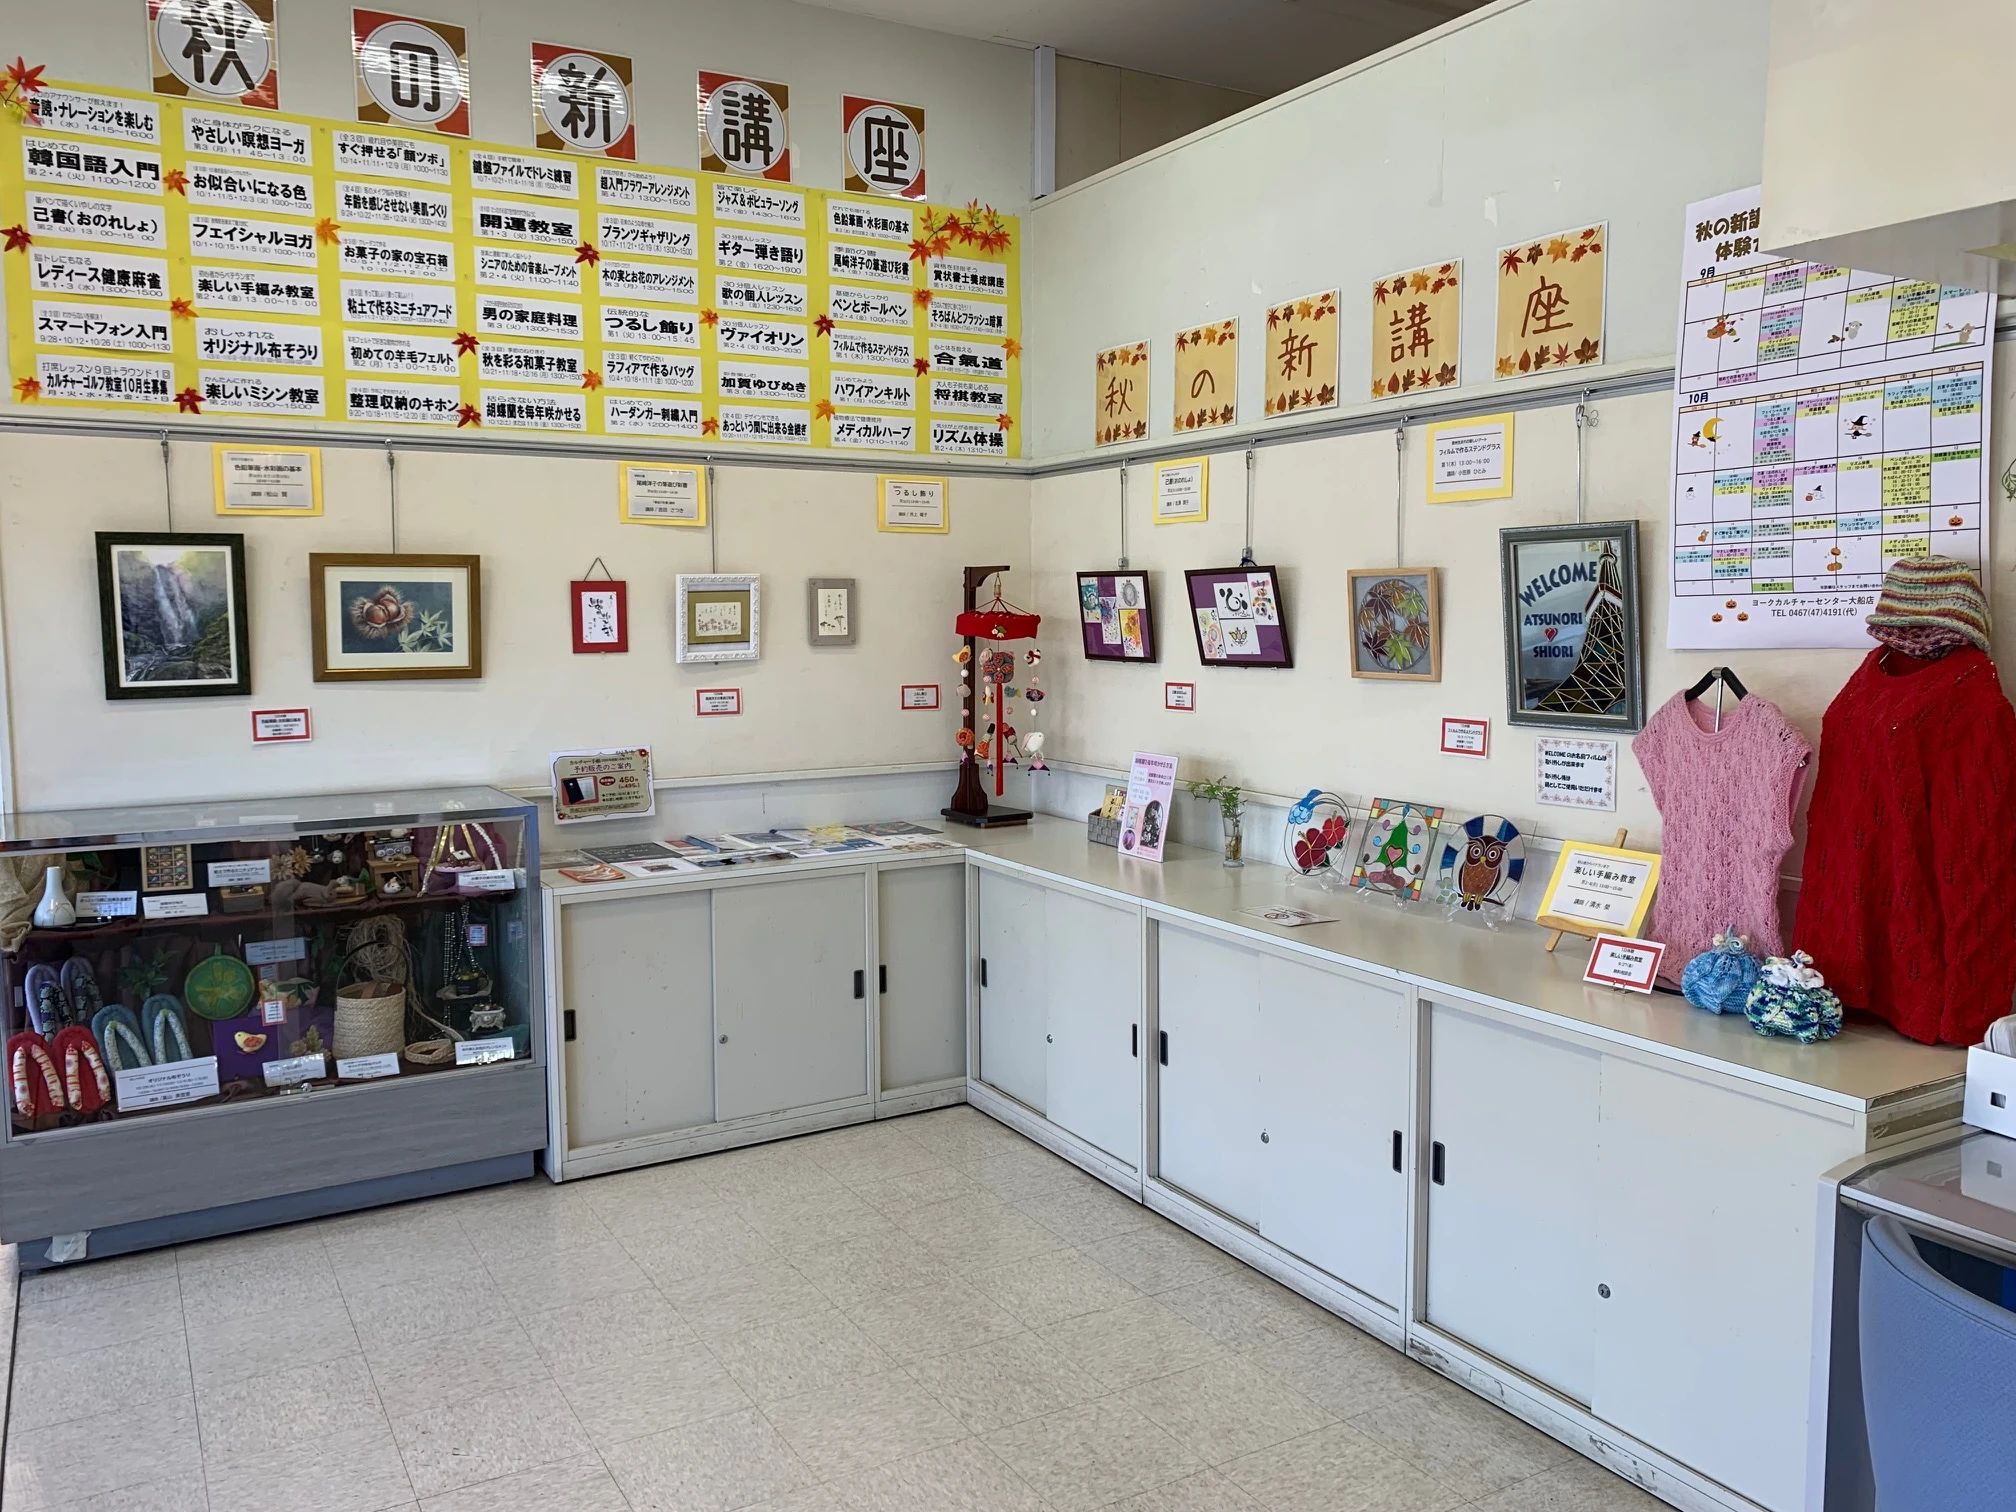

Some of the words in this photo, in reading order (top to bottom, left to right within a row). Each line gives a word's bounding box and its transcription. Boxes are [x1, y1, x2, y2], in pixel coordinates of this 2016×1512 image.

[180, 0, 254, 91] 秋
[558, 62, 615, 143] 新
[721, 90, 773, 166] 講
[864, 115, 910, 185] 座
[29, 97, 153, 131] 音読・ナレーションを楽しむ
[192, 118, 291, 136] 心と身体がラクになる
[26, 139, 79, 152] はじめての
[192, 125, 304, 154] やさしい瞑想ヨーガ
[28, 148, 159, 181] 韓国語入門
[338, 142, 444, 168] すぐ押せる「顔ツボ」
[473, 160, 571, 184] 鍵盤ファイルでドレミ練習
[194, 174, 307, 201] お似合いになる色
[601, 176, 690, 199] 超入門フラワーアレンジメント
[344, 194, 447, 218] 年齢を感じさせない美肌づくり
[33, 207, 157, 233] 己書（おのれしょ）
[480, 213, 573, 238] 開運教室
[834, 212, 909, 234] 色鉛筆画・水彩画の基本
[193, 224, 313, 249] フェイシャルヨガ
[602, 225, 690, 246] プランツギャザリング
[344, 246, 448, 267] お菓子の家の宝石箱
[719, 240, 803, 263] ギター弾き語り
[38, 263, 161, 289] レディース健康麻雀
[481, 257, 576, 278] シニアのための音楽ムーブメント
[1700, 266, 1715, 278] 9月
[602, 268, 694, 288] 木の実とお花のアレンジメント
[934, 270, 1004, 288] 賞状書士養成講座
[198, 279, 314, 299] 楽しい手編み教室
[722, 287, 803, 305] 歌の個人レッスン
[836, 290, 888, 301] 基礎からしっかり
[347, 298, 452, 319] 粘土で作るミニチュアフード
[482, 307, 578, 327] 男の家庭料理
[607, 308, 649, 318] 伝統的な
[833, 299, 907, 317] ペンとボールペン
[39, 317, 167, 341] スマートフォン入門
[605, 317, 693, 335] つるし飾り
[932, 310, 1002, 328] そろばんとフラッシュ暗算
[204, 328, 274, 339] おしゃれな
[721, 327, 804, 346] ヴァイオリン
[203, 338, 318, 360] オリジナル布ぞうり
[350, 346, 454, 366] 初めての羊毛フェルト
[833, 341, 909, 356] フィルムで作るステンドグラス
[1105, 375, 1134, 417] 秋
[1191, 370, 1215, 399] の
[1277, 328, 1319, 381] 新
[1390, 302, 1434, 363] 講
[1521, 275, 1574, 338] 座
[482, 353, 577, 373] 秋を彩る和菓子教室
[607, 361, 694, 378] ラフィアで作るバッグ
[47, 373, 168, 395] カルチャーゴルフ教室10月生募集
[204, 377, 262, 385] かんたんに作れる
[721, 377, 806, 393] 加賀ゆびぬき
[205, 383, 319, 404] 楽しいミシン教室
[350, 393, 459, 412] 整理収納のキホン
[835, 384, 910, 401] ハワイアンキルト
[934, 389, 1003, 404] 将棋教室
[1689, 392, 1709, 404] 10月
[486, 402, 581, 422] 胡蝶蘭を毎年咲かせる
[611, 407, 697, 423] ハーダンガー刺繍入門
[723, 420, 807, 436] あっという間に出来る金継ぎ
[837, 423, 911, 439] メディカルハーブ
[934, 430, 1003, 447] リズム体操
[1519, 562, 1597, 607] WELCOME
[1752, 596, 1874, 608] ヨークカルチャーセンター大船店
[1788, 607, 1858, 617] 0467(47)4191(代)
[1524, 612, 1582, 626] ATSUNORI
[1533, 646, 1573, 658] SHIORI
[574, 762, 632, 773] 予約販売のご案内
[1574, 866, 1636, 884] 楽しい手編み教室
